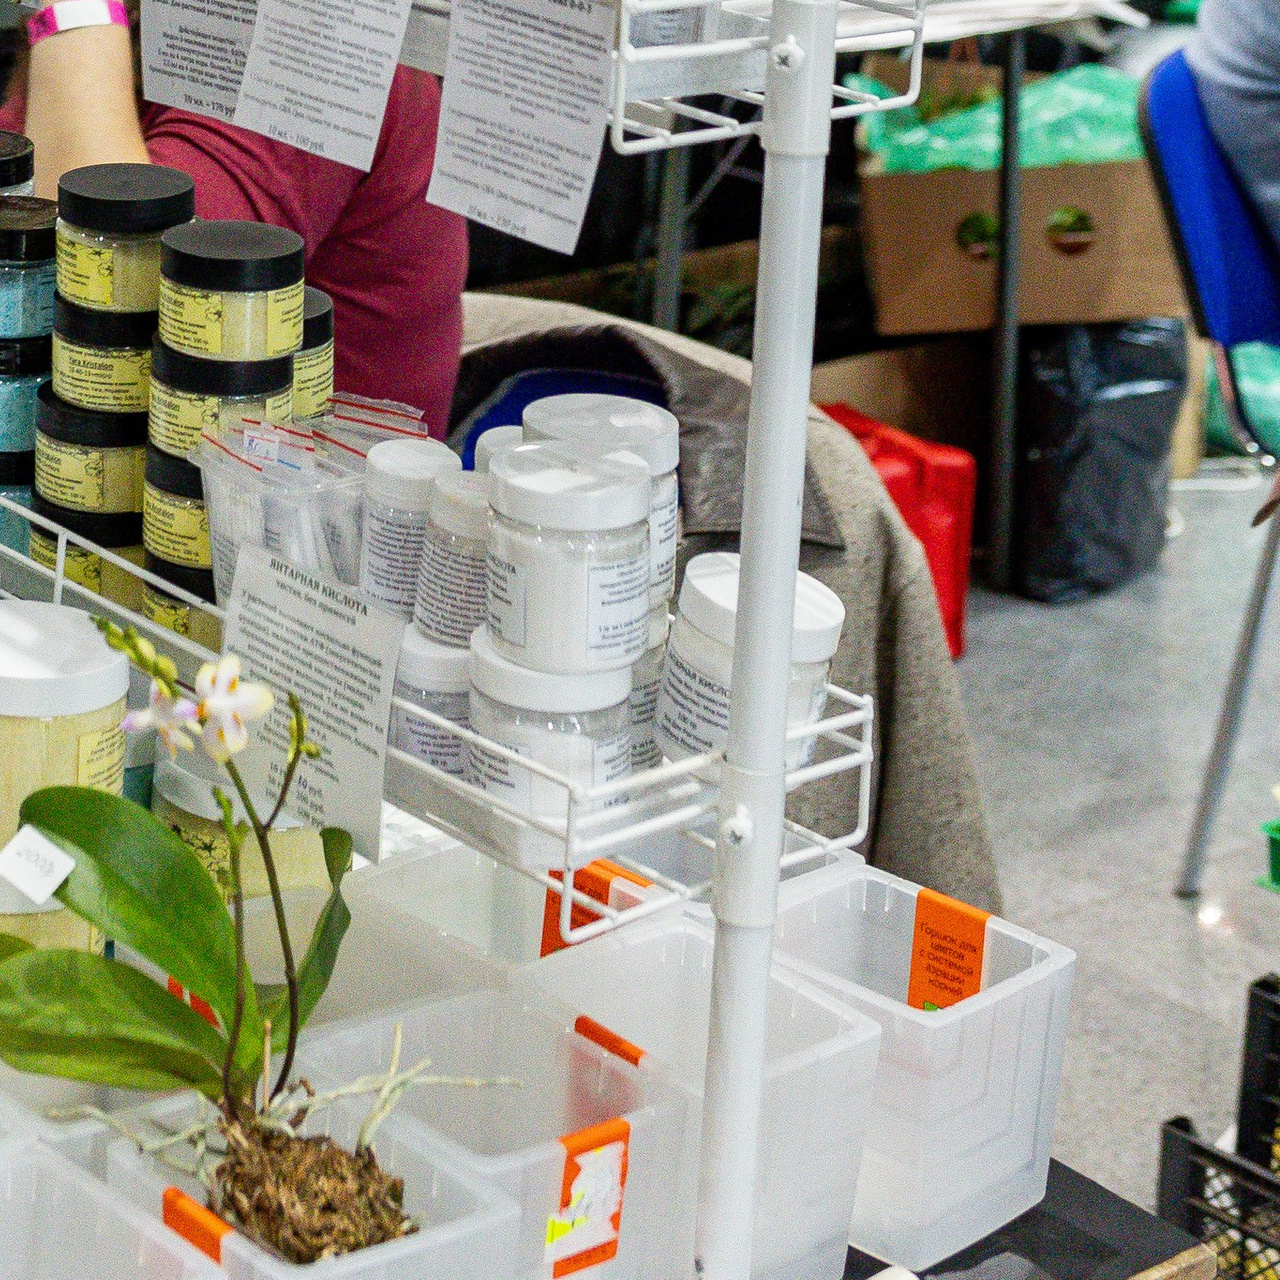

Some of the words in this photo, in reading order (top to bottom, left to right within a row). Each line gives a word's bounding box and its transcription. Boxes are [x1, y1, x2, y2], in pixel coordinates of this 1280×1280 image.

[270, 559, 321, 591] ЯНТАРНАЯ
[321, 586, 368, 615] КИСЛОТА
[920, 921, 957, 945] Горшок
